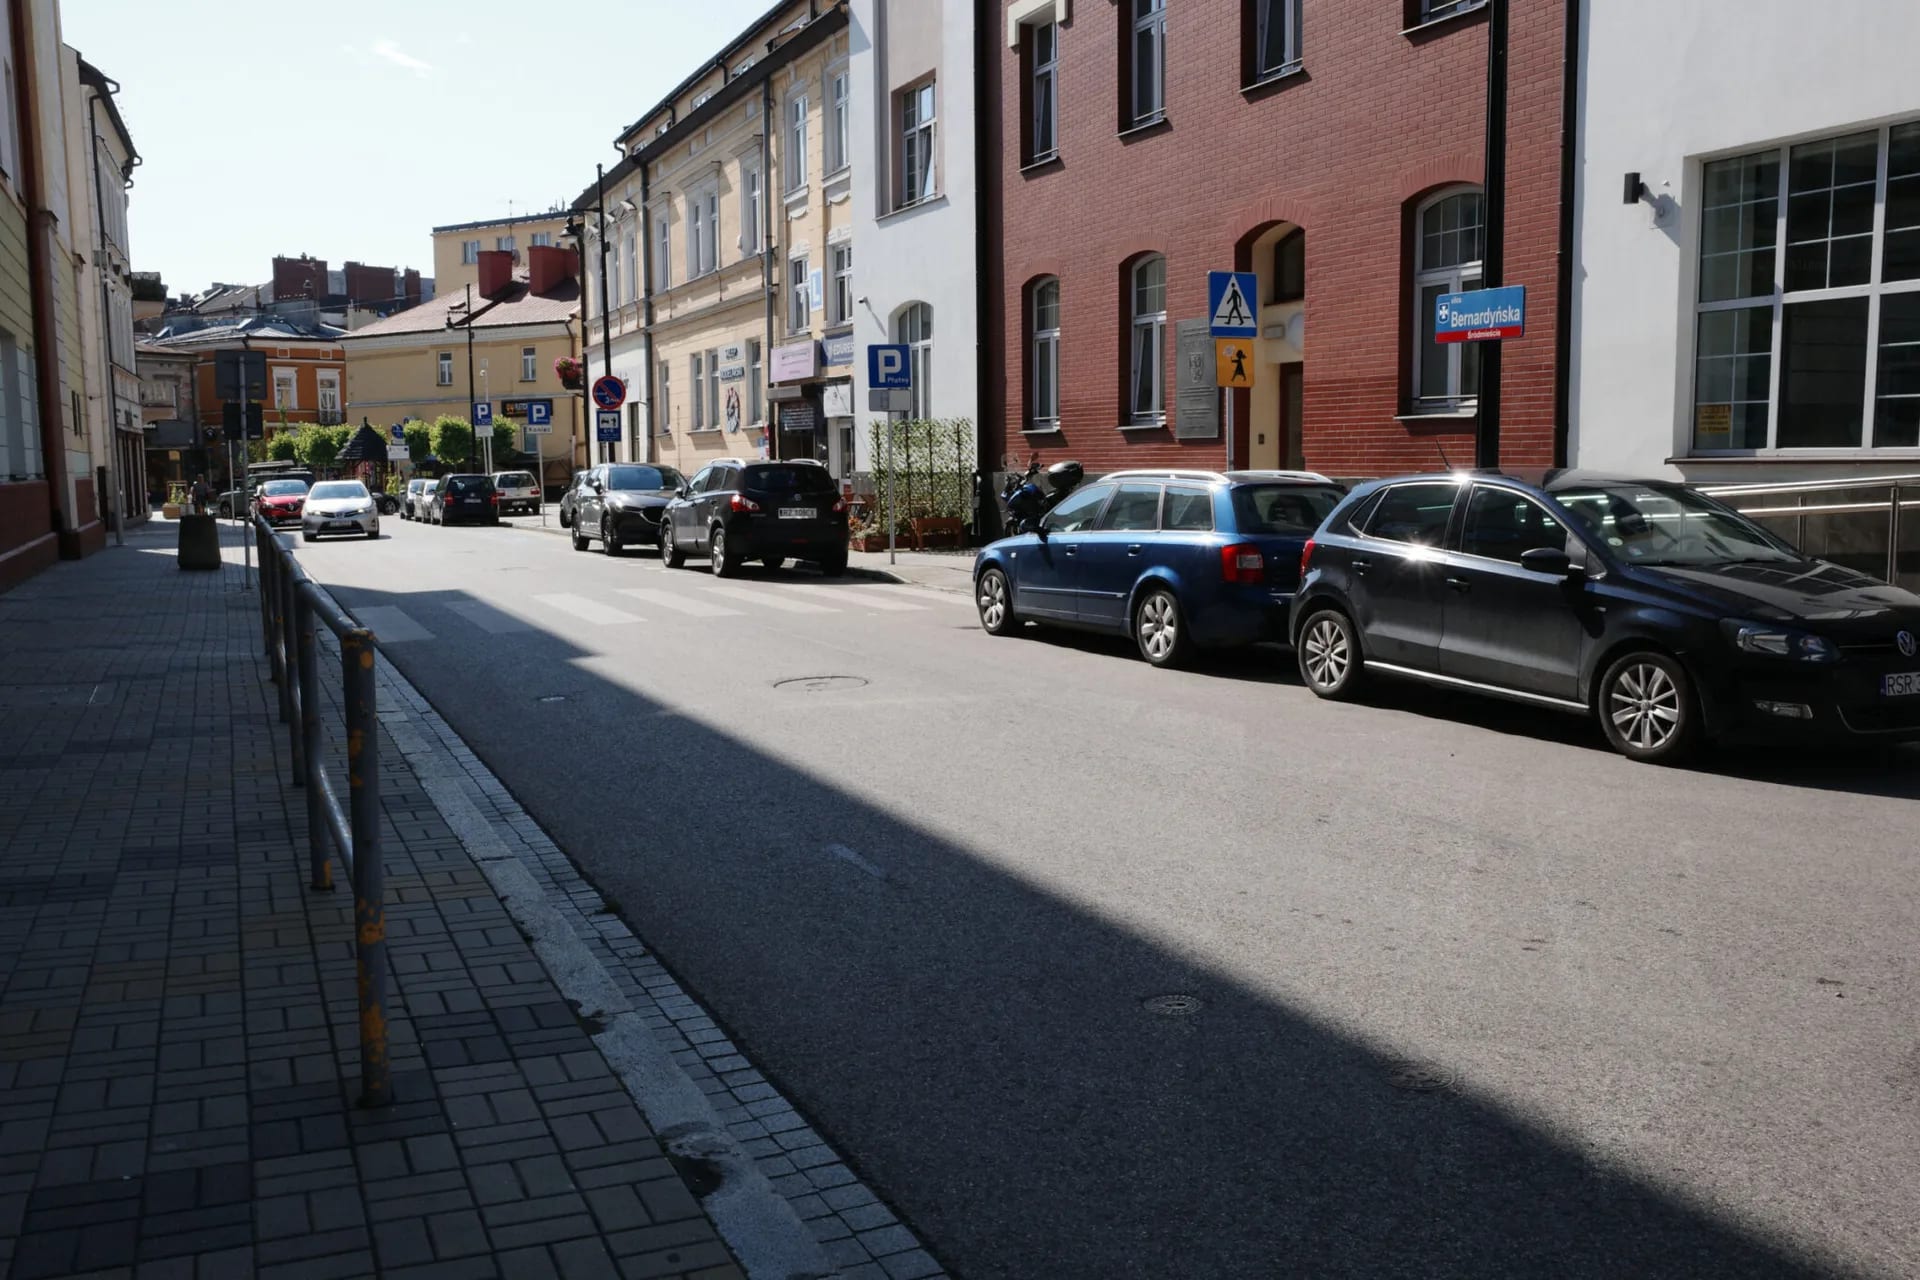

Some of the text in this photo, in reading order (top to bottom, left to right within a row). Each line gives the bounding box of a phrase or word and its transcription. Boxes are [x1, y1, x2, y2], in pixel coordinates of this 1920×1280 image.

[1451, 304, 1520, 328] Bernardyńska
[878, 349, 902, 383] P
[477, 403, 489, 419] P
[532, 404, 546, 422] P
[1887, 674, 1912, 695] RSR
